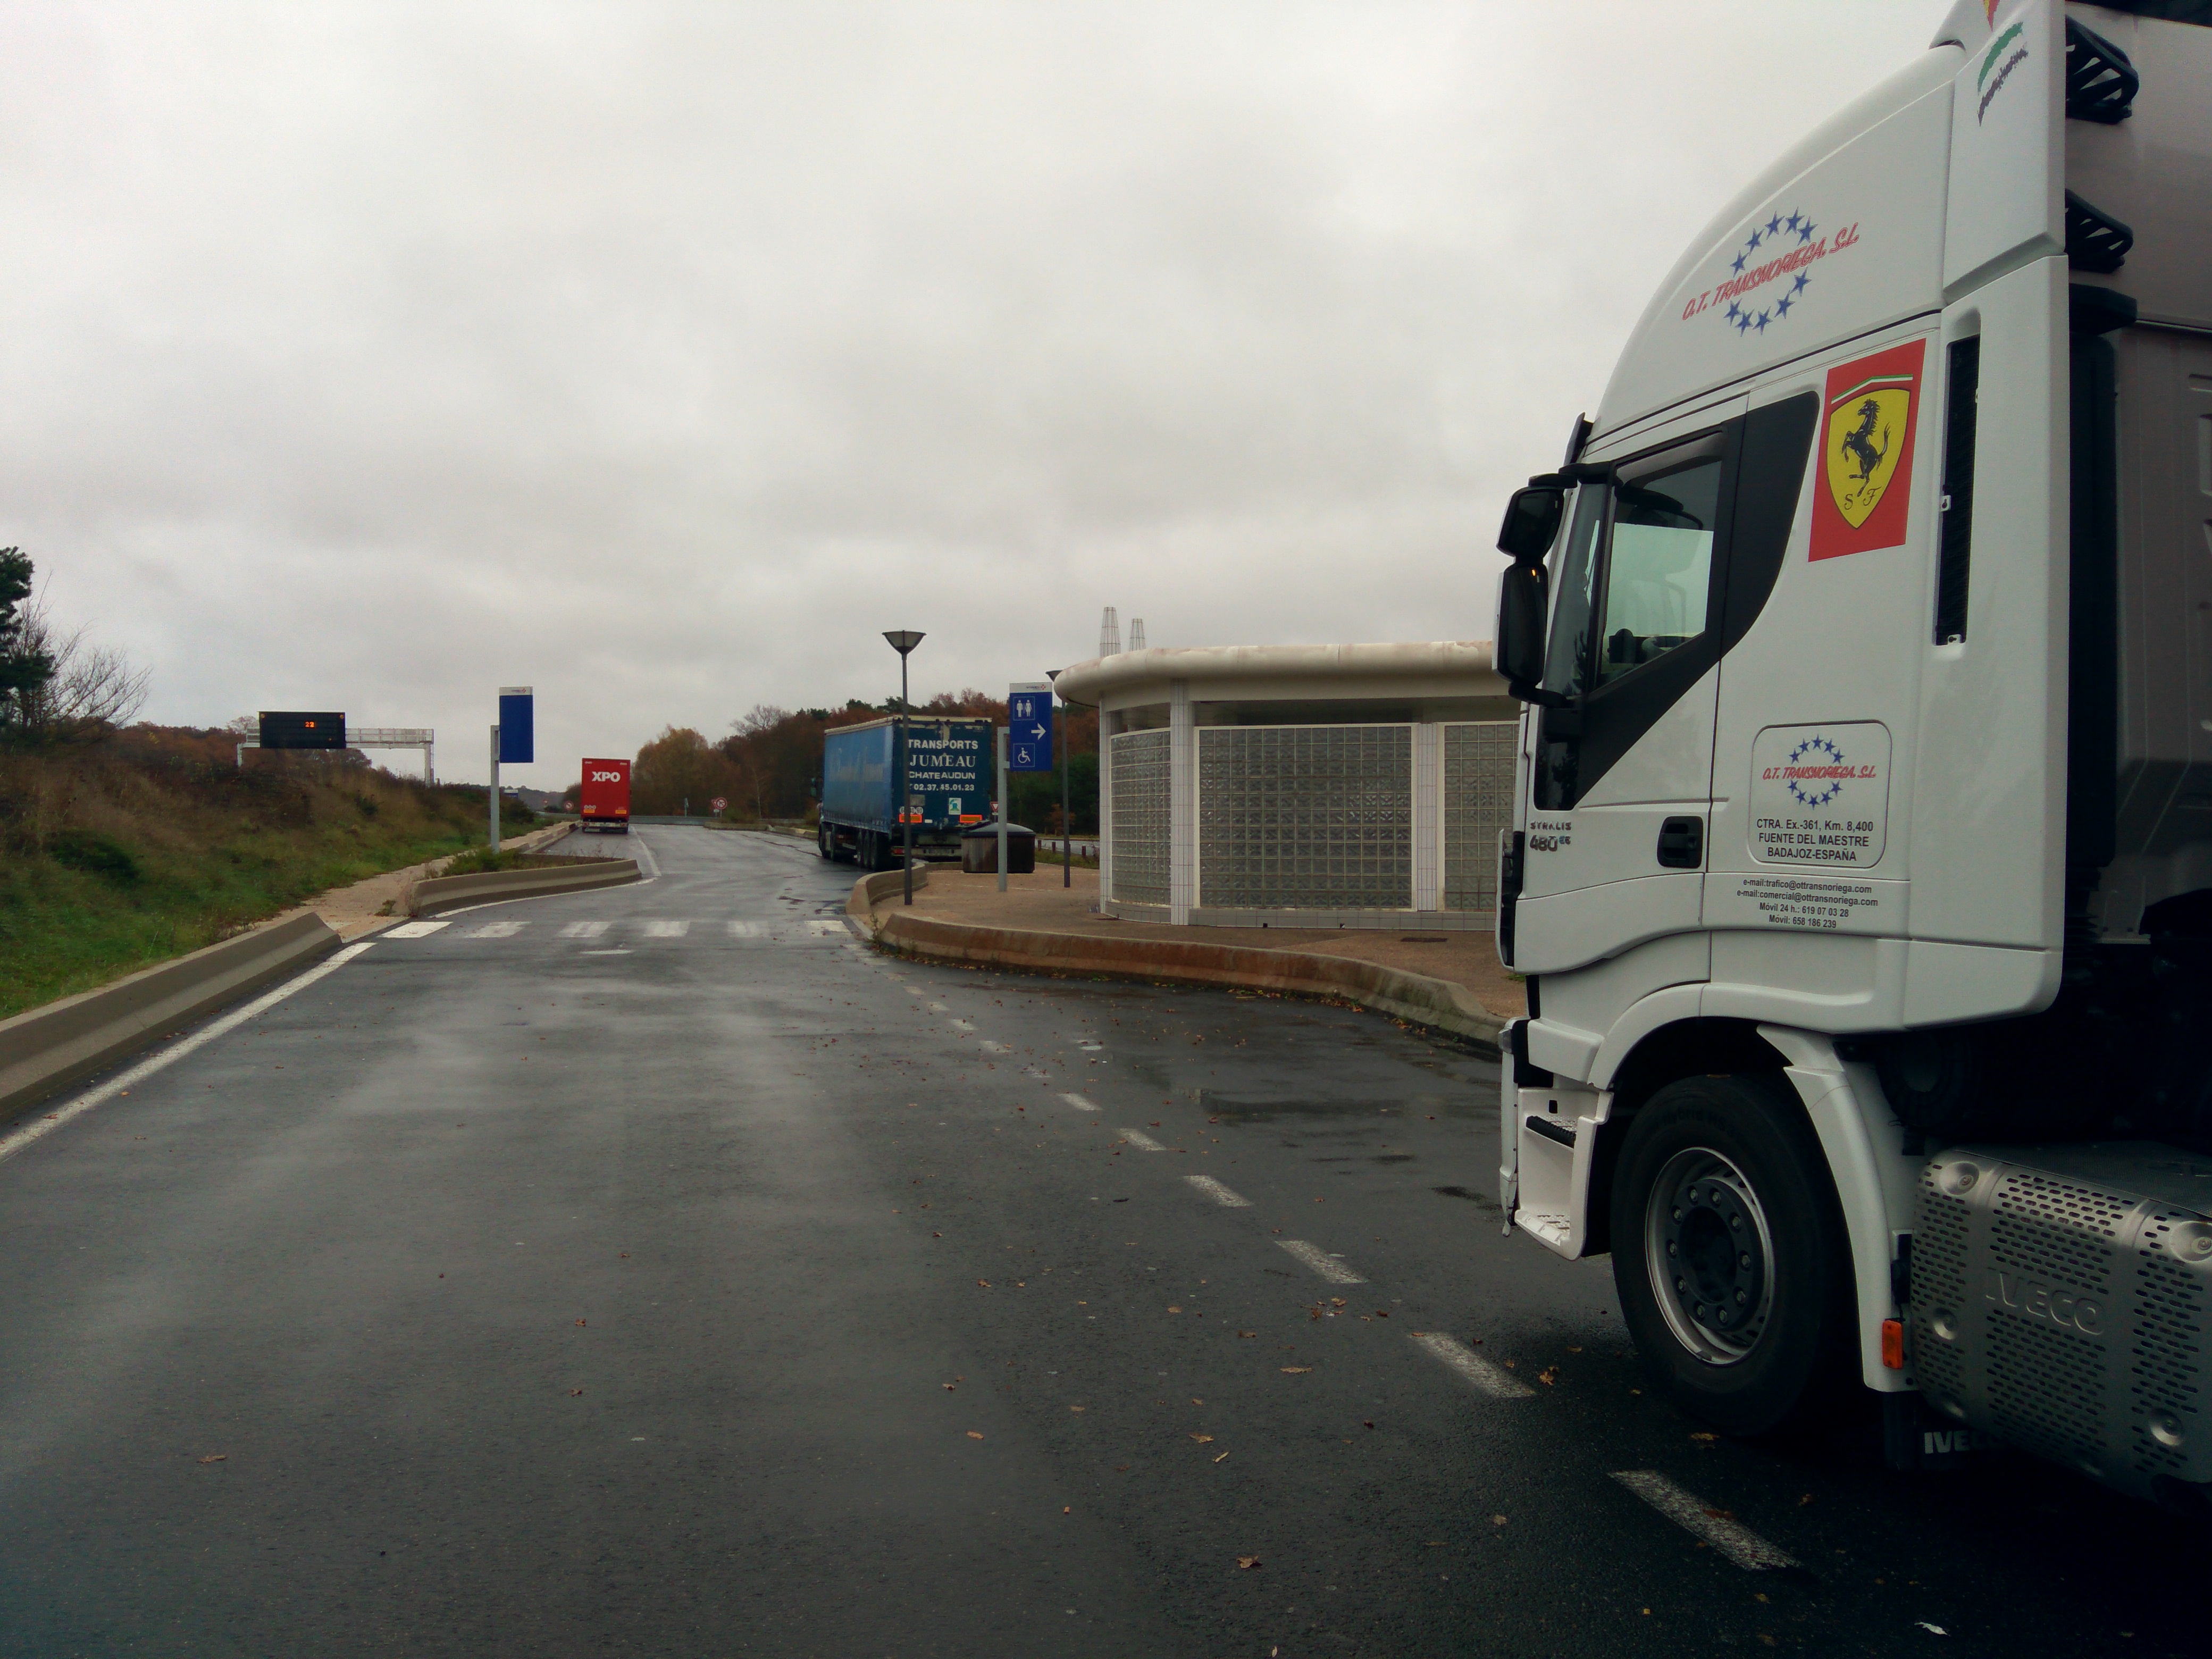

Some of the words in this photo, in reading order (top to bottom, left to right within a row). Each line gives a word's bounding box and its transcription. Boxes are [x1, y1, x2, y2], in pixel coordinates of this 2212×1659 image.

[1829, 222, 1860, 254] S.L.
[1844, 493, 1853, 510] S
[908, 739, 978, 750] TRANSPORTS
[910, 755, 976, 768] JUMEAU
[592, 771, 621, 783] XPO
[909, 771, 976, 780] CHATEAUDUN
[1857, 765, 1876, 778] S.L.
[1530, 822, 1572, 831] STRALIS
[1756, 818, 1783, 829] CTRA.
[1824, 820, 1844, 831] Km.
[1847, 821, 1874, 833] 8,400
[1529, 834, 1558, 852] 480
[1758, 832, 1795, 844] FUENTE
[1797, 834, 1816, 844] DEL
[1819, 834, 1870, 847] MAESTRE
[1767, 847, 1857, 861] BADAJOZ-ESPAÑA
[1743, 878, 1872, 894] e-mail:trafico@ottransnoriega.com
[1737, 889, 1878, 907] e-mail:comercial@ottransnoriega.com
[1759, 902, 1778, 911] Móvil
[1780, 903, 1789, 912] 24
[1802, 906, 1815, 915] 619
[1817, 907, 1826, 915] 07
[1828, 908, 1838, 917] 03
[1839, 908, 1849, 918] 28
[1792, 916, 1806, 926] 658
[1807, 918, 1821, 927] 186
[1823, 919, 1837, 928] 239
[1985, 1267, 2106, 1336] IVECO
